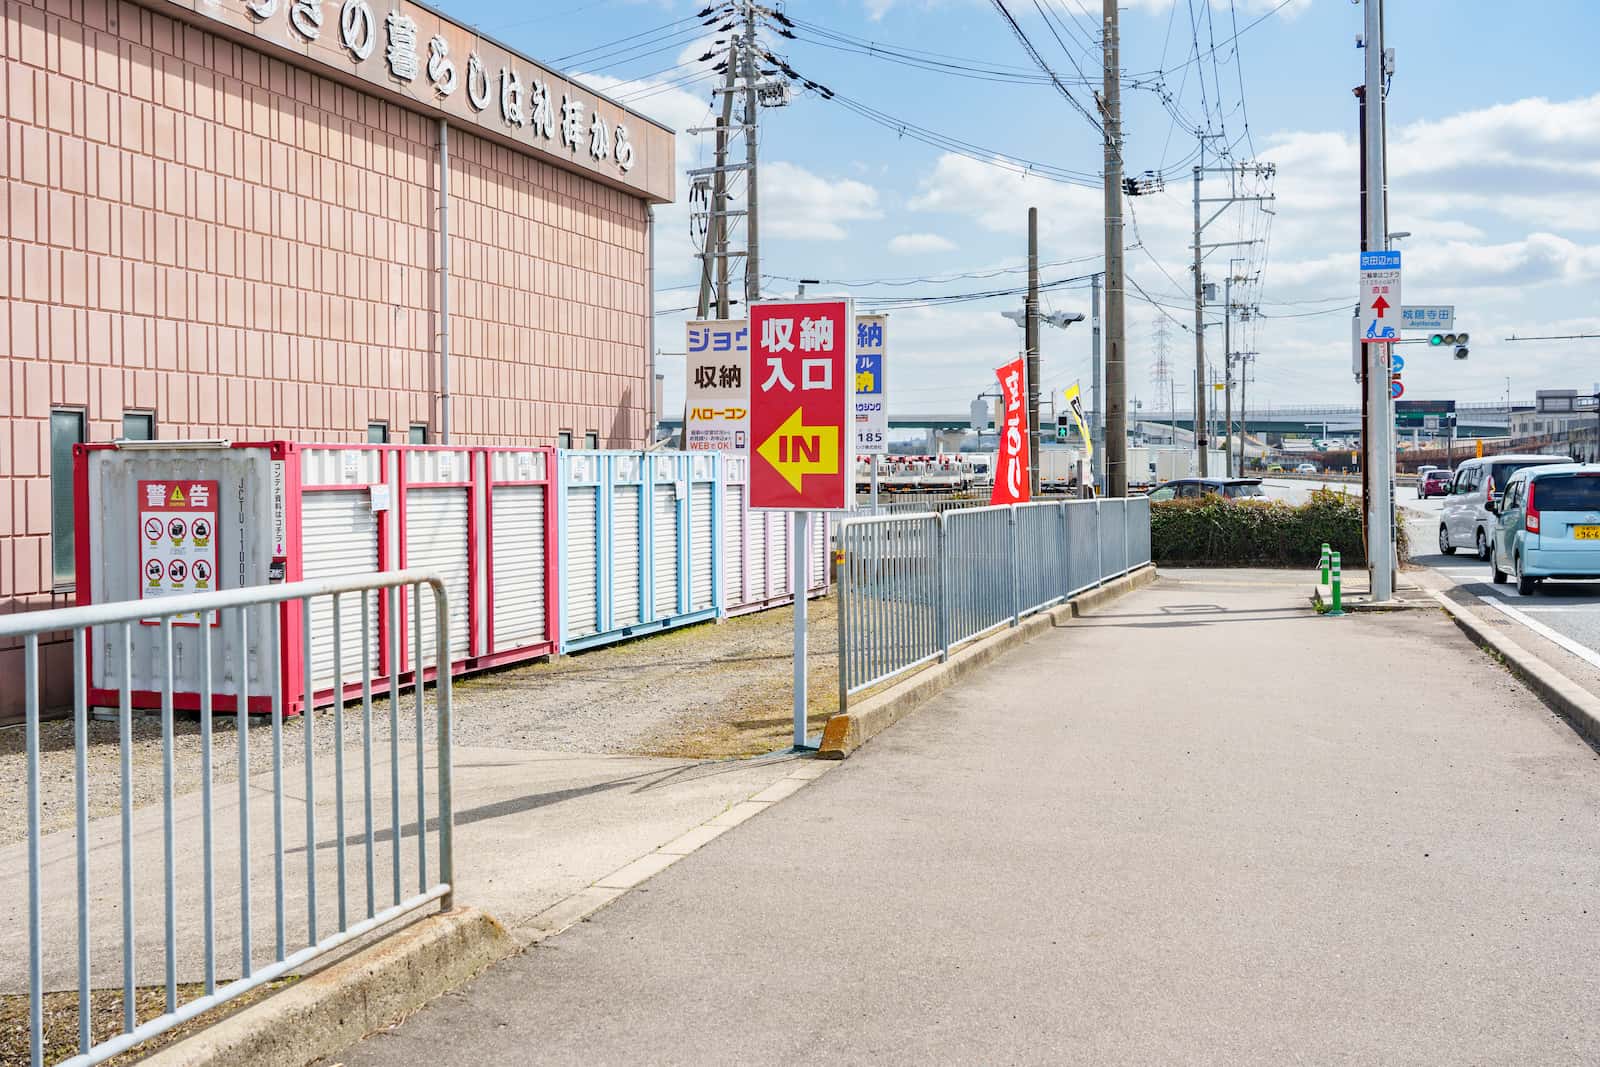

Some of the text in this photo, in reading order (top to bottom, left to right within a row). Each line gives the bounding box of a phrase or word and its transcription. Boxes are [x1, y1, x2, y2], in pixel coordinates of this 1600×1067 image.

[760, 316, 834, 353] 収納
[694, 364, 742, 389] 収納
[761, 358, 833, 393] 入口
[690, 406, 747, 421] ハローコン
[778, 435, 821, 463] IN
[857, 432, 883, 442] 185
[146, 484, 210, 507] 警告
